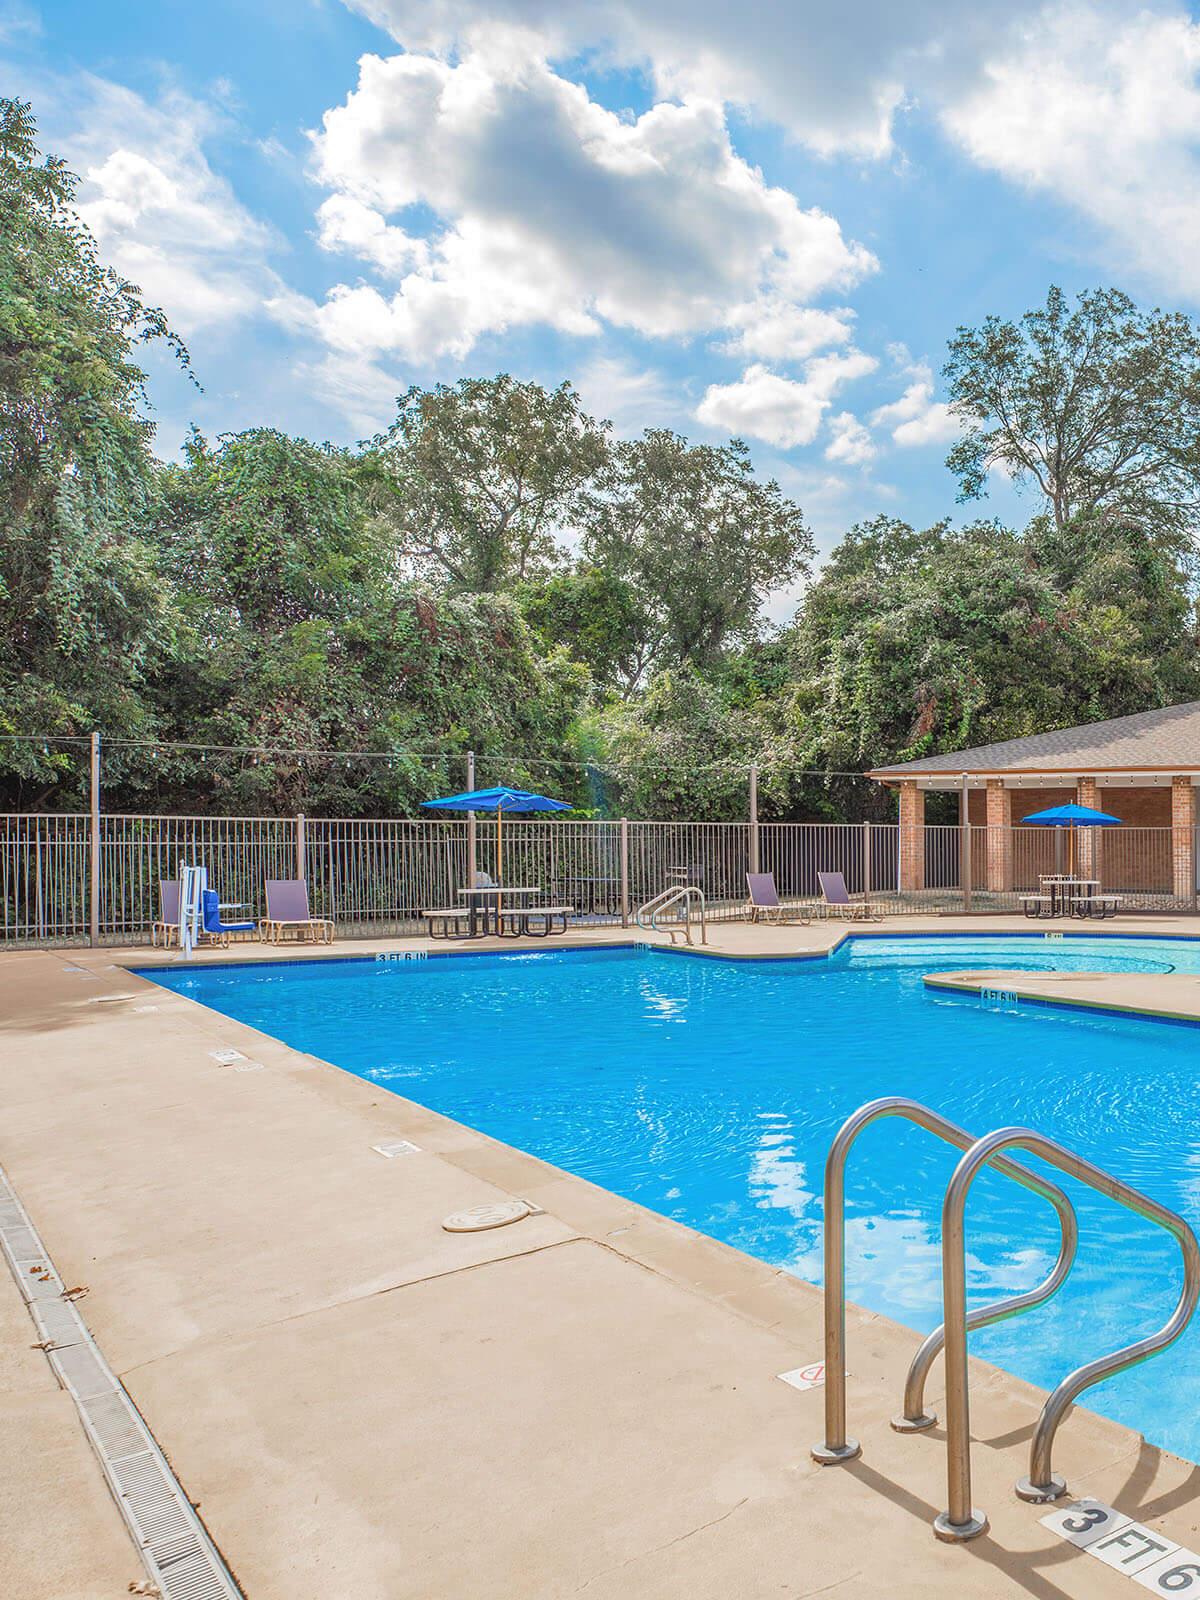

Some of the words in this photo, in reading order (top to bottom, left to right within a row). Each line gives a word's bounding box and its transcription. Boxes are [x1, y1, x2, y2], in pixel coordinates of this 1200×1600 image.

[380, 954, 386, 962] 3
[390, 953, 401, 961] FT
[405, 953, 412, 961] 6
[416, 952, 426, 960] IN
[1008, 992, 1017, 1001] IN
[1062, 1508, 1108, 1533] 3
[1096, 1528, 1168, 1565] FT
